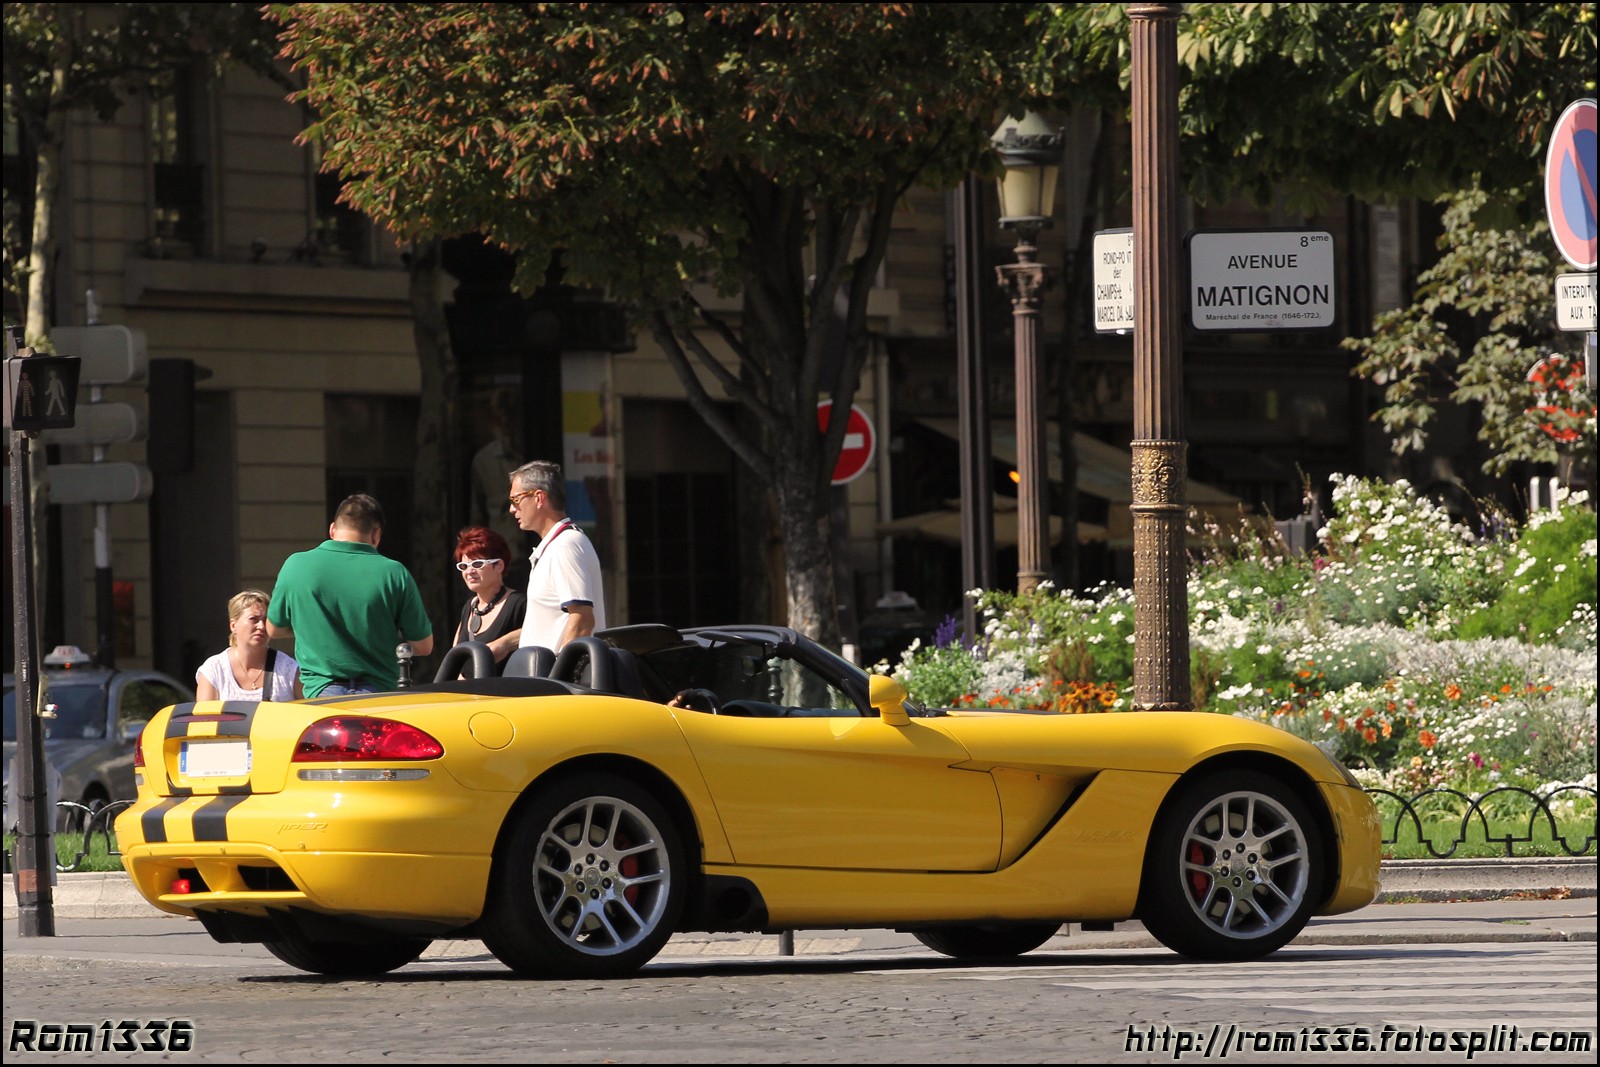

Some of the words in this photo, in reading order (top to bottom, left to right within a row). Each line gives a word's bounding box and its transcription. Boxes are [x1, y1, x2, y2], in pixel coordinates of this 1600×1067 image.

[1103, 251, 1132, 265] ROND-PONT
[1227, 254, 1298, 270] AVENUE
[1197, 284, 1329, 307] MATIGNON
[1561, 284, 1591, 299] INTERDIT
[1253, 312, 1278, 320] France
[1570, 306, 1584, 320] AUX
